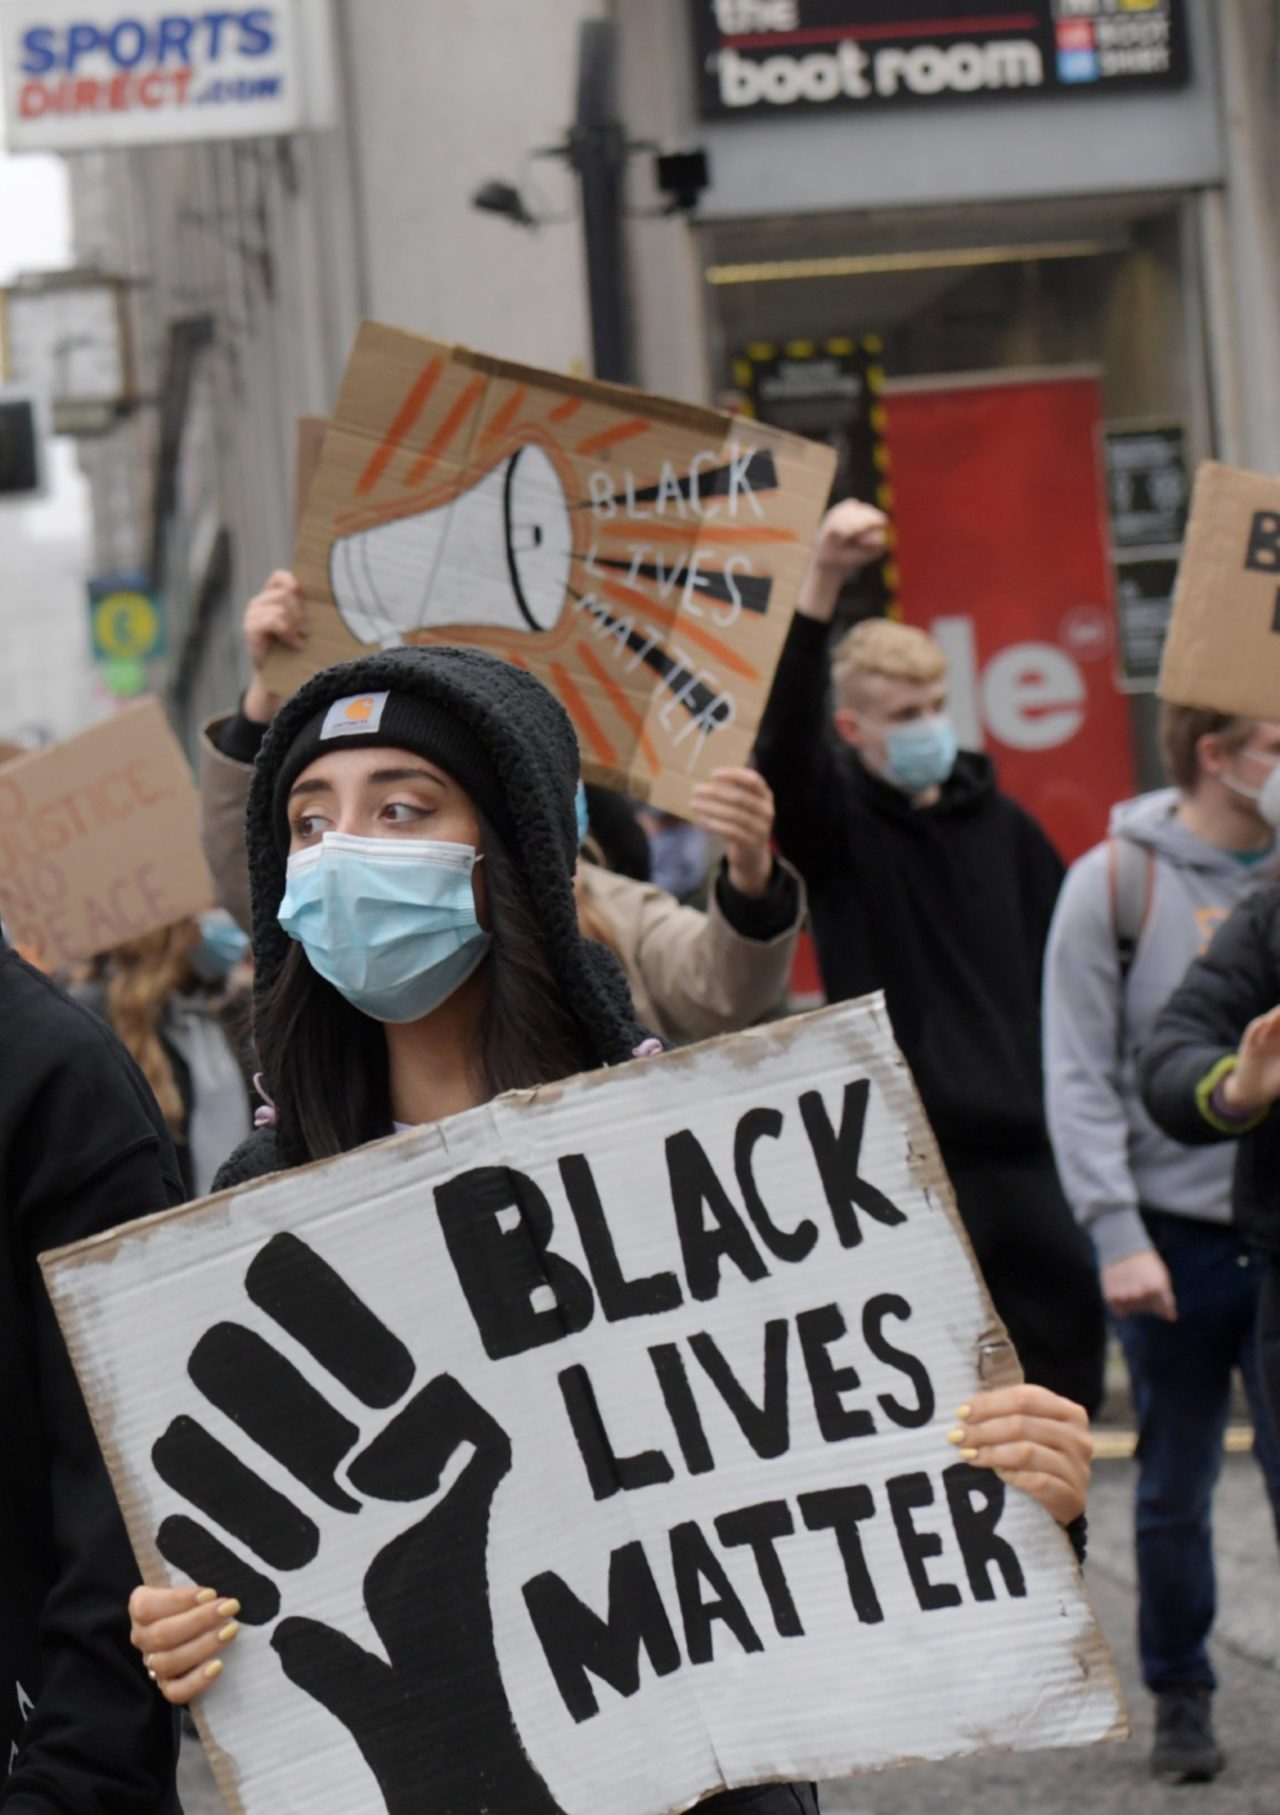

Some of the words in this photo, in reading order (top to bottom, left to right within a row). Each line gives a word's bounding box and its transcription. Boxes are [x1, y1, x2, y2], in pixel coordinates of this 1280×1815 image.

[22, 8, 276, 76] SPORTS
[719, 40, 871, 107] boot
[874, 40, 1042, 96] room
[588, 438, 765, 520] BLACK
[583, 545, 752, 627] LIVES
[574, 592, 736, 772] MATTER
[433, 1078, 907, 1361] BLACK
[558, 1293, 936, 1501] LIVES
[521, 1461, 1027, 1725] MATTER
